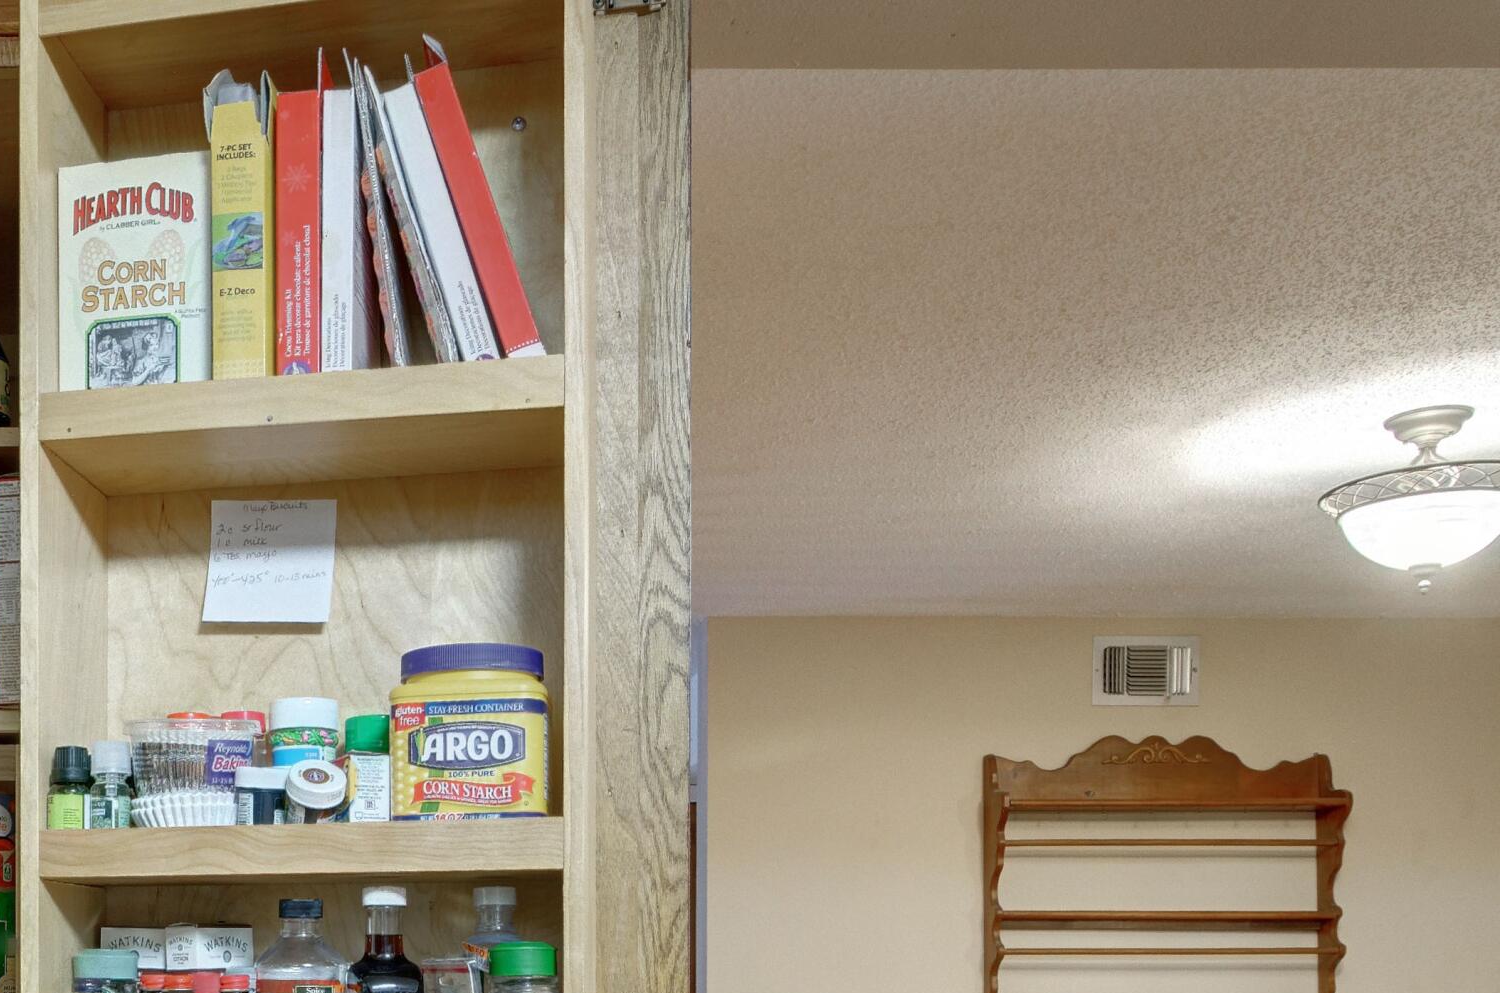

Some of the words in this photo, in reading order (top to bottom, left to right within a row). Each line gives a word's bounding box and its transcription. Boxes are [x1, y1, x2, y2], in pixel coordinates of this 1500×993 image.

[241, 143, 252, 151] SET
[72, 186, 145, 236] HEARTH
[145, 182, 195, 223] CLUB
[97, 259, 167, 285] CORN
[81, 282, 187, 313] STARCH
[219, 287, 233, 297] E-Z
[235, 286, 255, 296] Deco
[476, 703, 524, 712] CONTAINER
[399, 716, 420, 726] free
[421, 730, 513, 762] ARGO
[423, 780, 460, 796] CORN
[463, 784, 512, 799] STARCH
[107, 935, 163, 953] WATKINS
[168, 935, 194, 946] WATKINS
[204, 936, 248, 953] WATKINS
